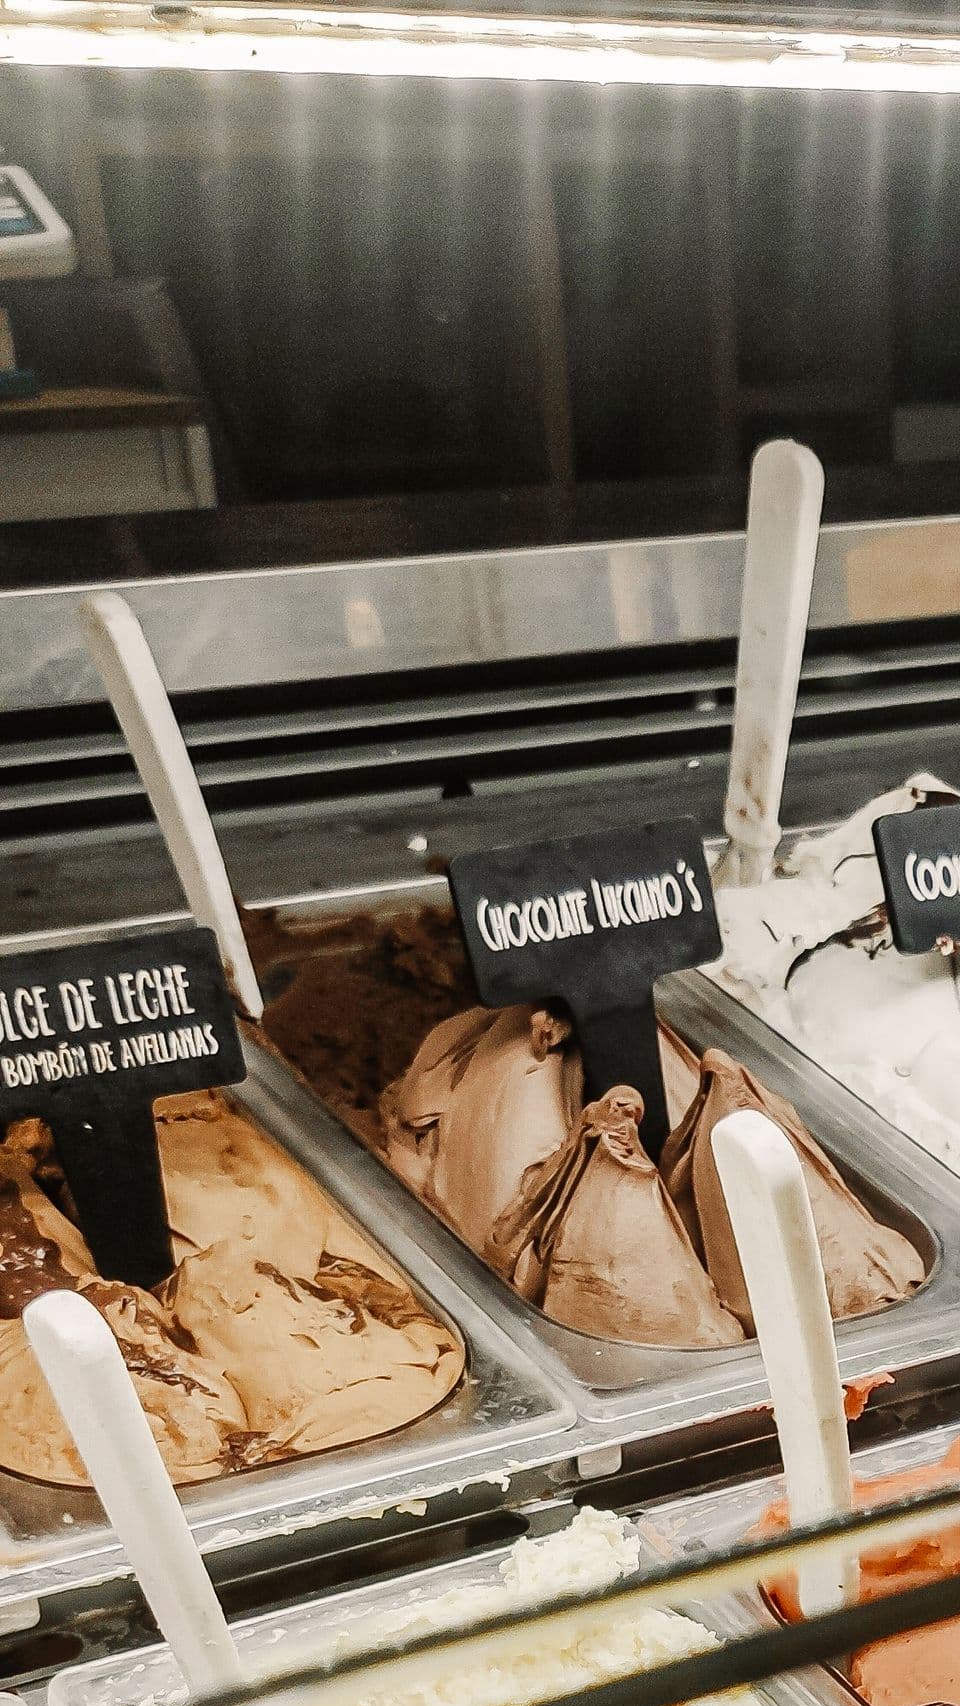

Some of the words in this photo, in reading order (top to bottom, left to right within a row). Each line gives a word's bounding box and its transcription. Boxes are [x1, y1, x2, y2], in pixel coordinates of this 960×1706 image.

[477, 888, 595, 951] CHOCOLATE
[0, 985, 56, 1043] LCE
[58, 978, 103, 1033] DE
[104, 964, 196, 1025] LECHE
[1, 1041, 89, 1088] BOMBÓN
[89, 1041, 118, 1074] DE
[120, 1023, 220, 1069] AVELLANAS
